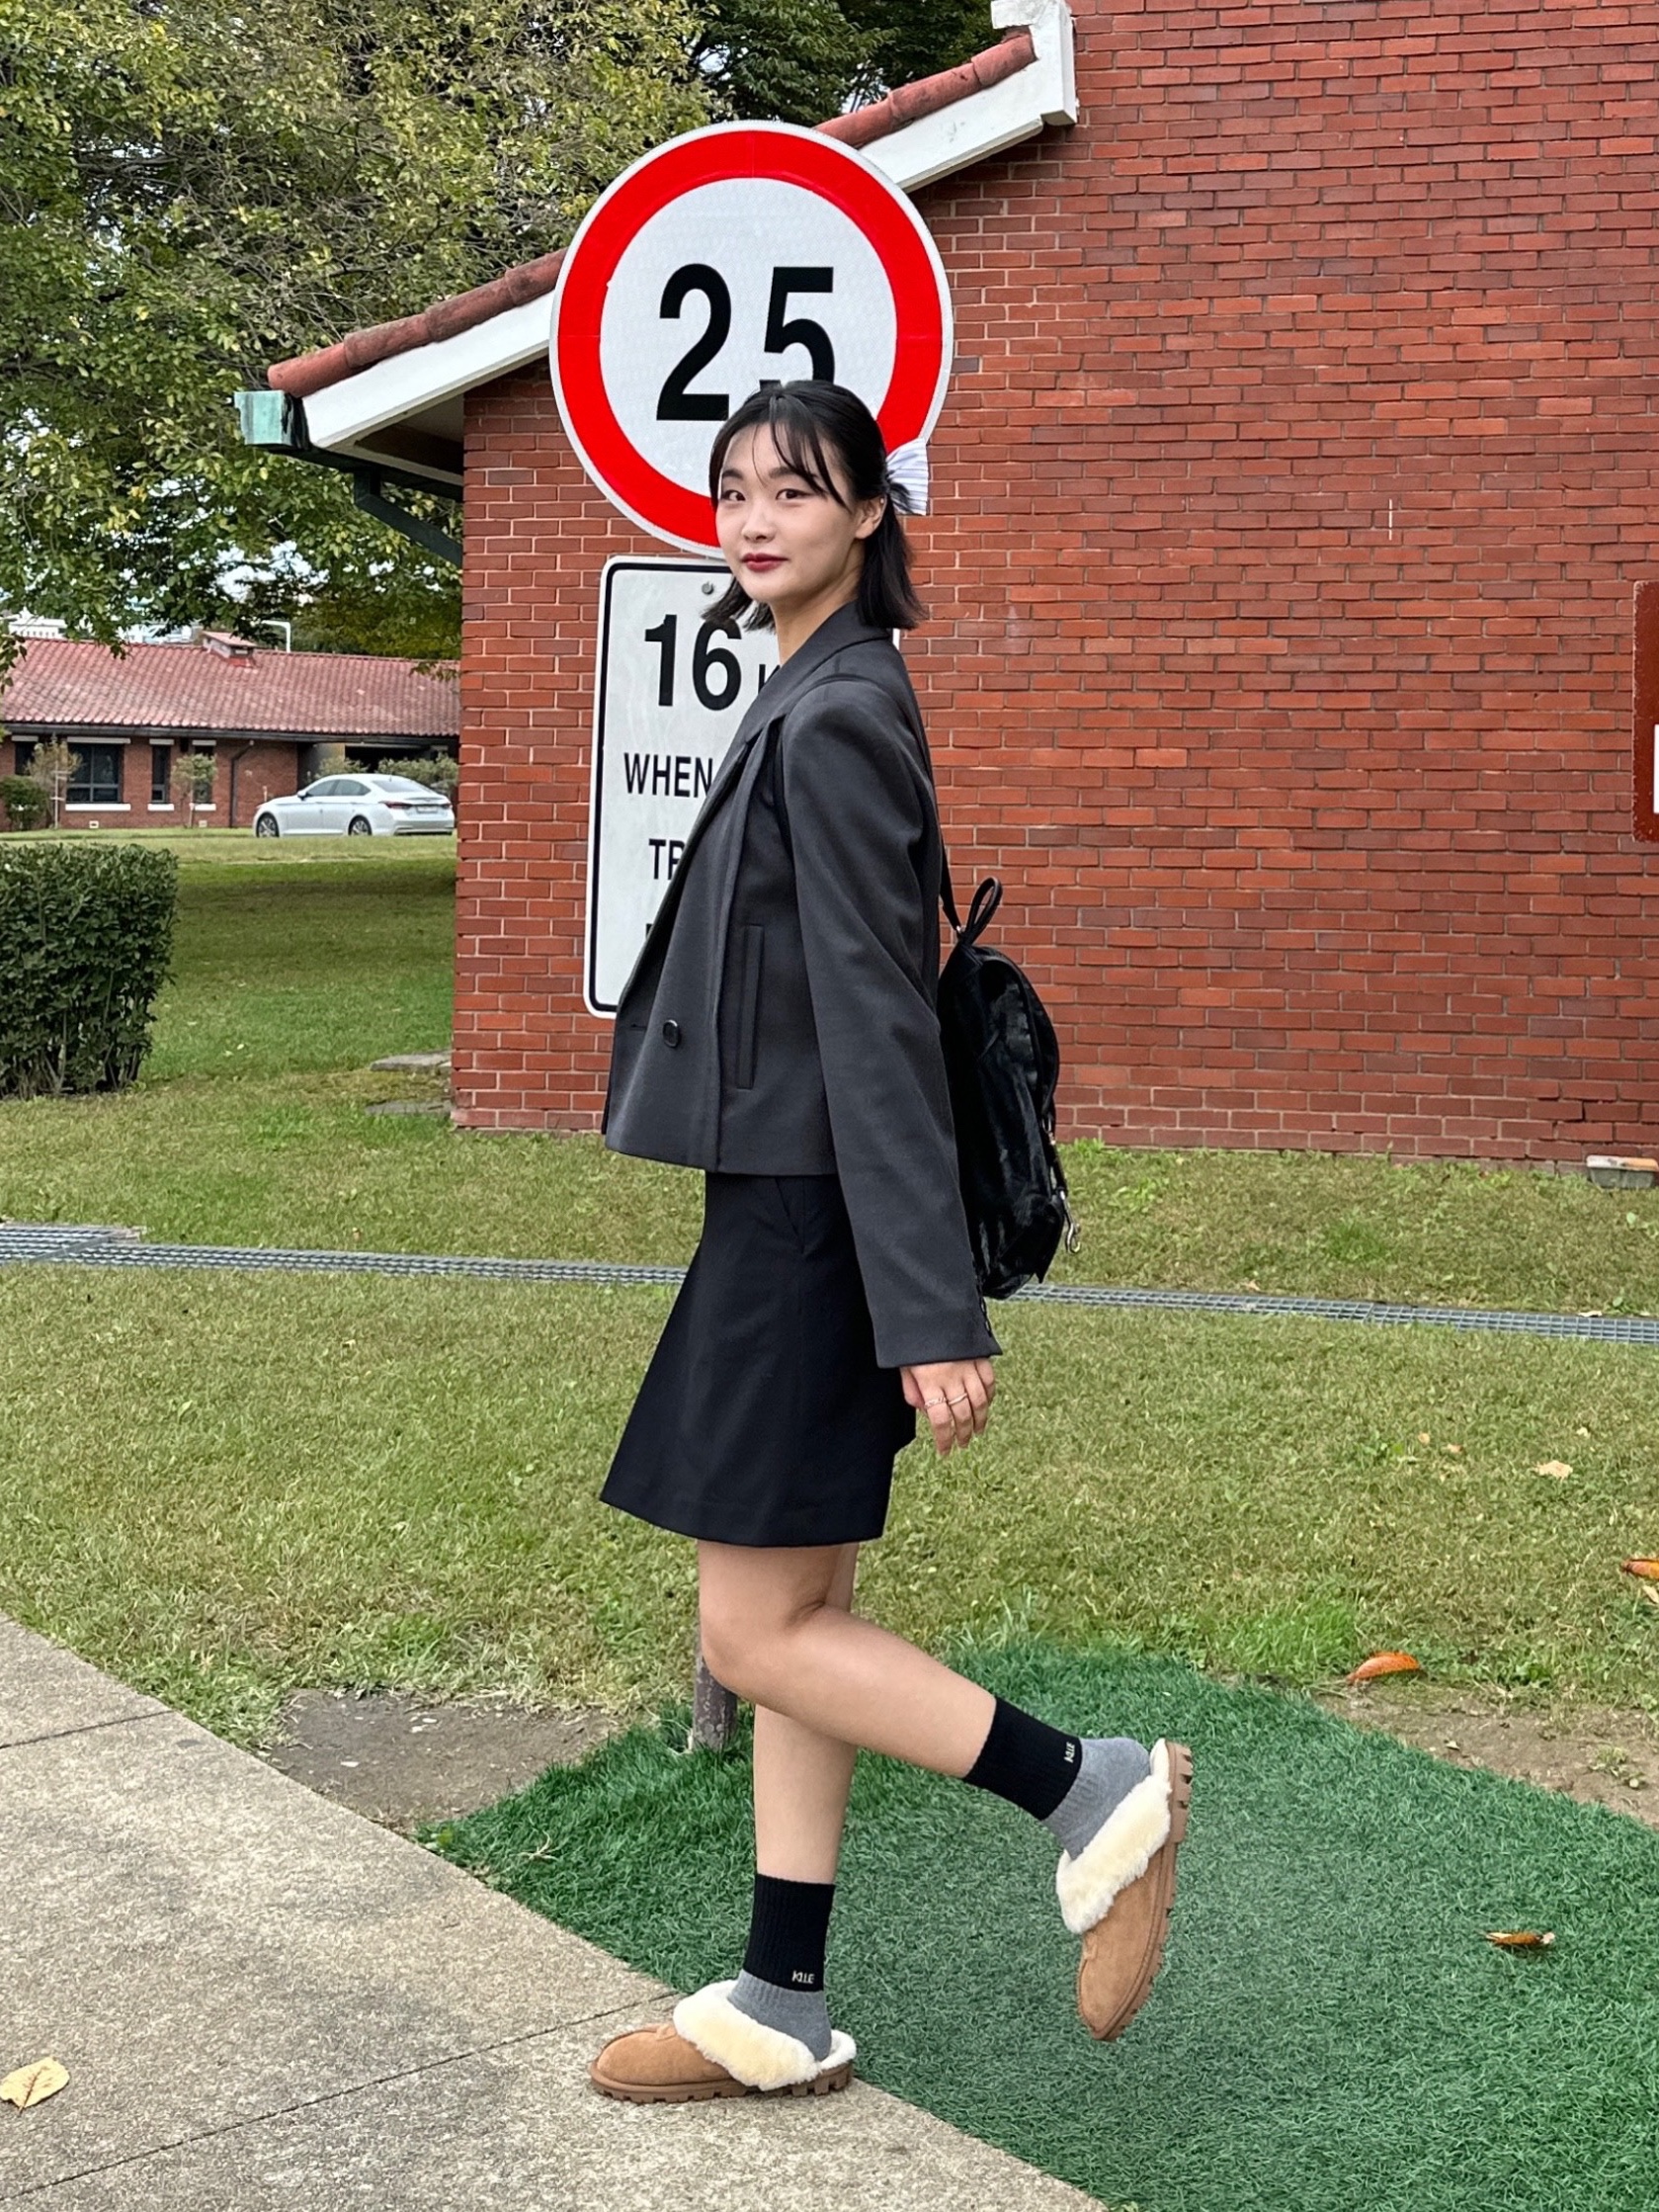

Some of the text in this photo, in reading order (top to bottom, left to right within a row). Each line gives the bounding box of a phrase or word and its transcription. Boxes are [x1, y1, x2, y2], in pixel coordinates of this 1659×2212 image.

[656, 263, 835, 421] 25
[644, 614, 742, 711] 16
[623, 752, 713, 798] WHEN
